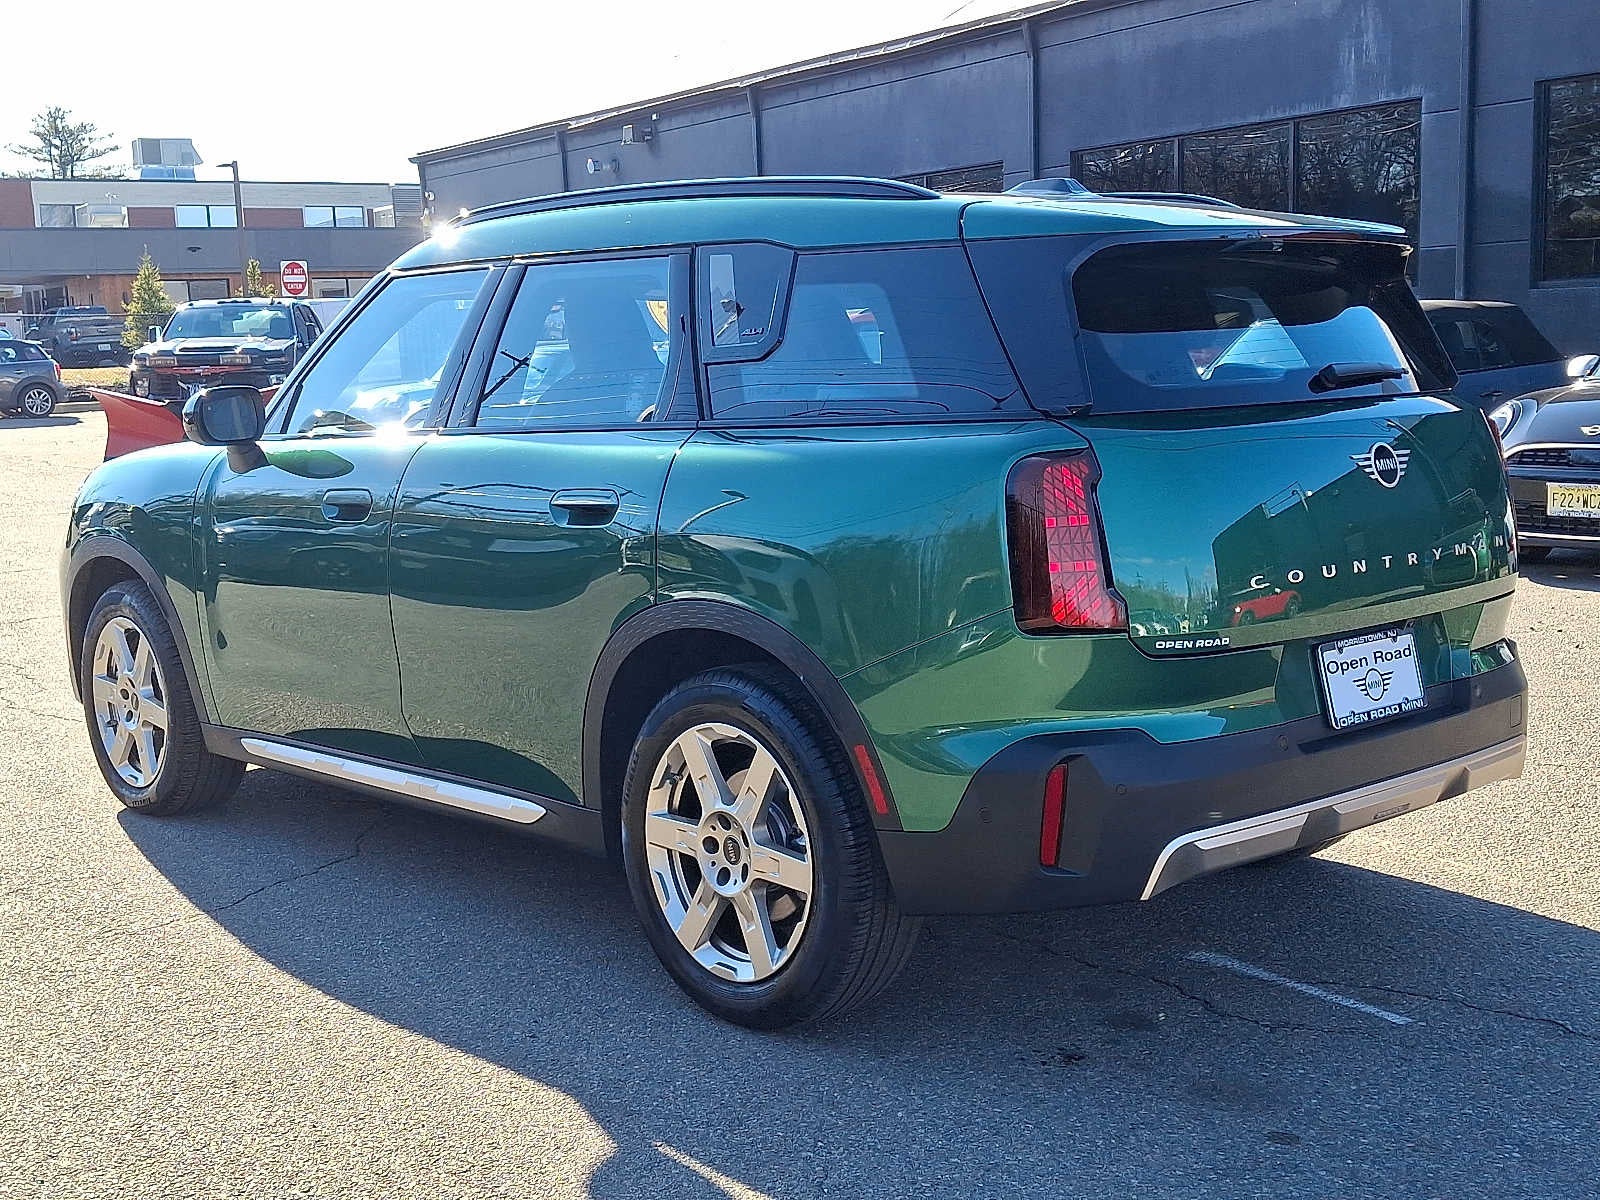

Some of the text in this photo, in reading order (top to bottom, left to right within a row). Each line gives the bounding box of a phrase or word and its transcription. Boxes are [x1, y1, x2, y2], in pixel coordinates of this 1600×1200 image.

[1375, 458, 1397, 471] MINI
[1553, 492, 1574, 508] F22
[1250, 535, 1505, 589] COUNTRYMAN
[1387, 629, 1397, 638] NJ
[1155, 637, 1230, 649] OPEN ROAD
[1326, 644, 1412, 675] Open Road
[1367, 679, 1382, 690] MINI
[1340, 699, 1423, 727] OPEN ROAD MINI
[727, 839, 736, 862] MINI
